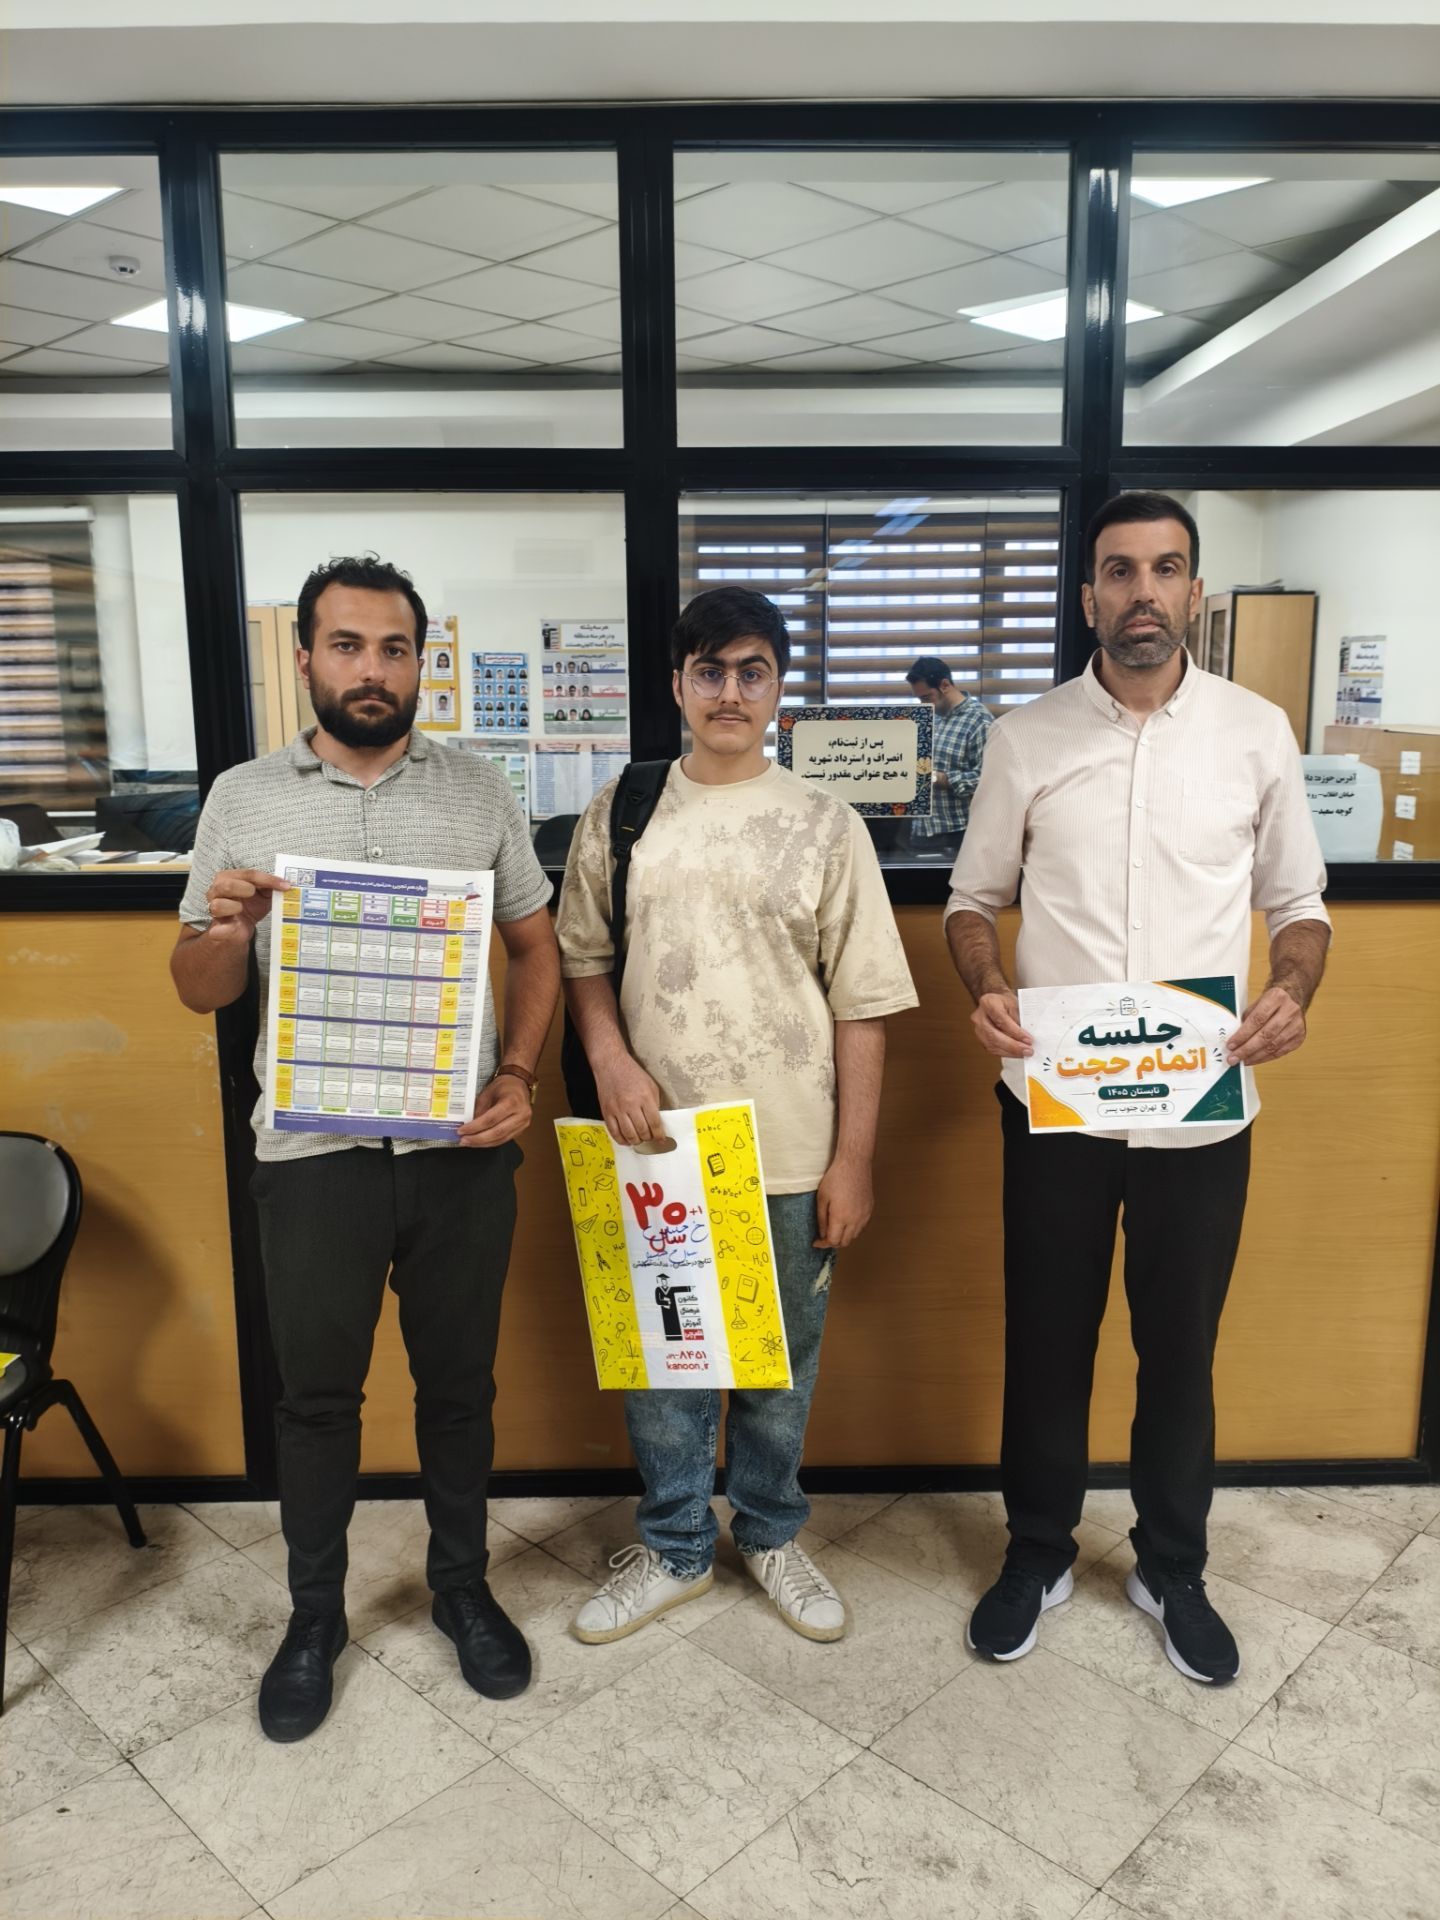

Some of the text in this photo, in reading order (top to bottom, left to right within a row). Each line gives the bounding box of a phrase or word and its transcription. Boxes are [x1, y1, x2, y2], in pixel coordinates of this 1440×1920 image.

[860, 738, 868, 750] از
[870, 739, 884, 749] پس
[808, 753, 903, 766] انصراف و استرداد شهریه
[801, 770, 908, 780] به هیچ عنوانی مقدور نیست.
[1078, 1016, 1182, 1050] جلسه
[1056, 1047, 1206, 1081] اتمام حجت
[1130, 1086, 1160, 1097] تابستان
[1140, 1104, 1156, 1112] تهران
[678, 1294, 698, 1304] کانون
[680, 1306, 700, 1316] فرهنگی
[682, 1318, 702, 1328] آموزش
